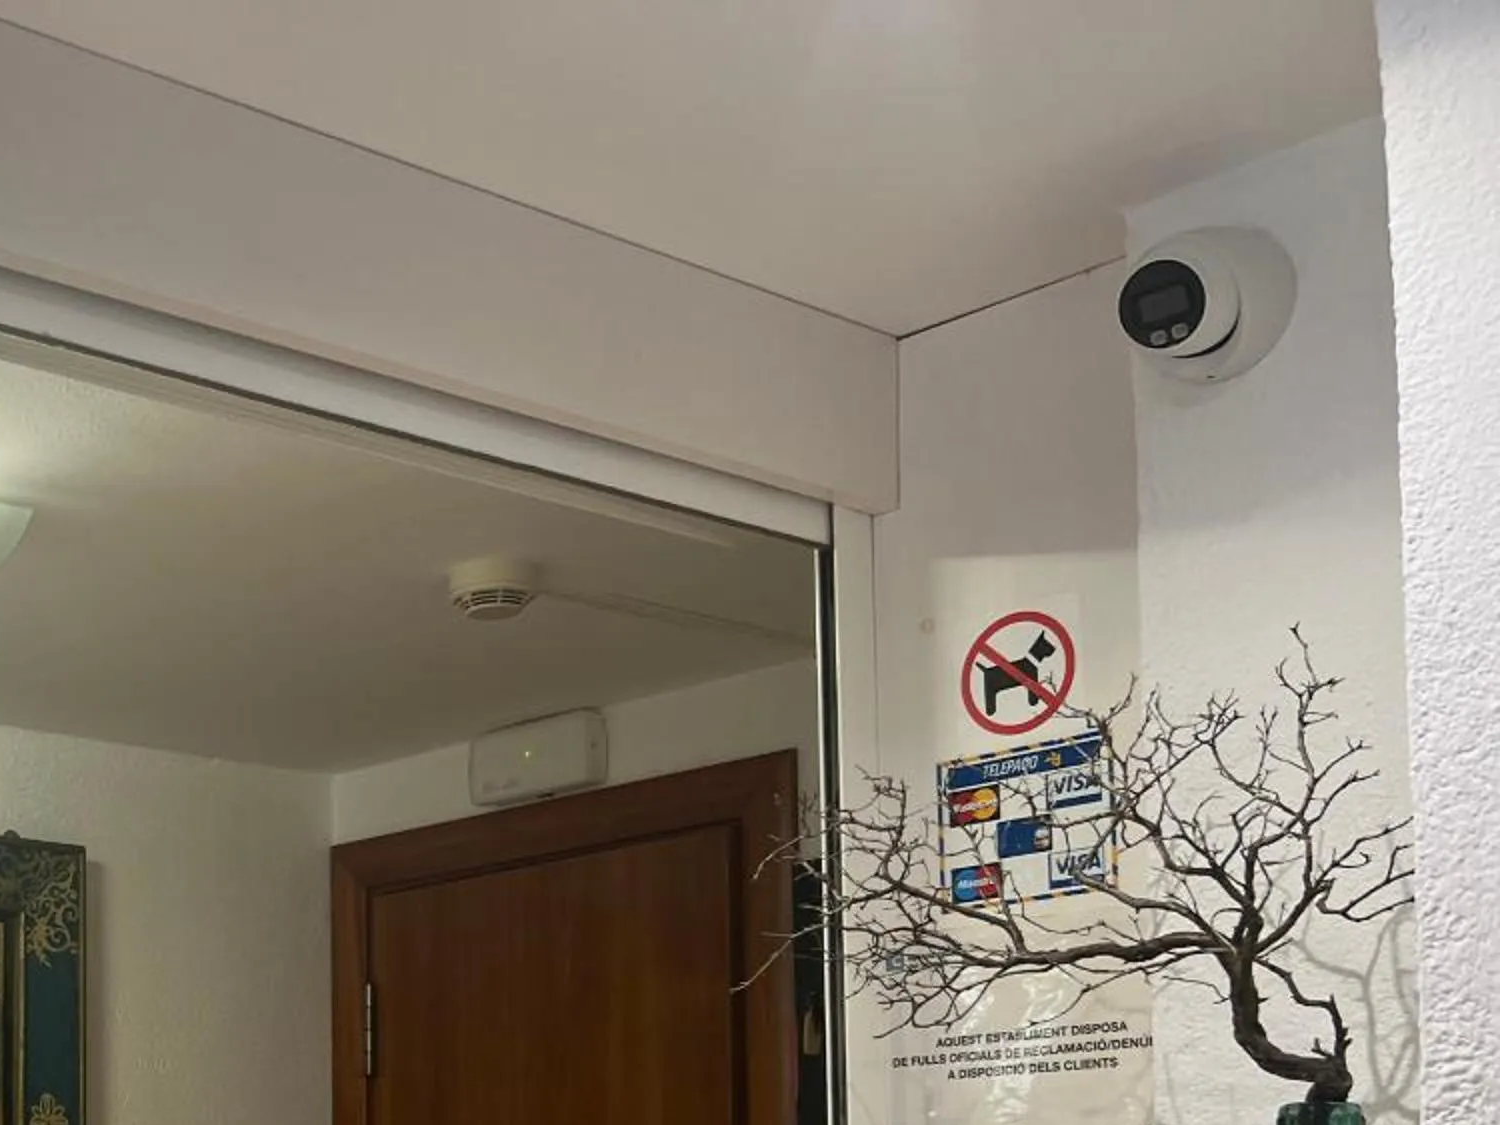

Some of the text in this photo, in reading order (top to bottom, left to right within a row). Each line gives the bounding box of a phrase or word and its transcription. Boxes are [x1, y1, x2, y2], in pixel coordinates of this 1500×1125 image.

[935, 1033, 983, 1049] AQUEST
[1071, 1020, 1128, 1037] DISPOSA
[892, 1034, 1153, 1069] DE FULLS OFICIALS DE RECLAMACIÓ/DENÚ
[947, 1069, 956, 1080] A
[1028, 1061, 1061, 1075] DELS
[1063, 1055, 1119, 1072] CLIENTS
